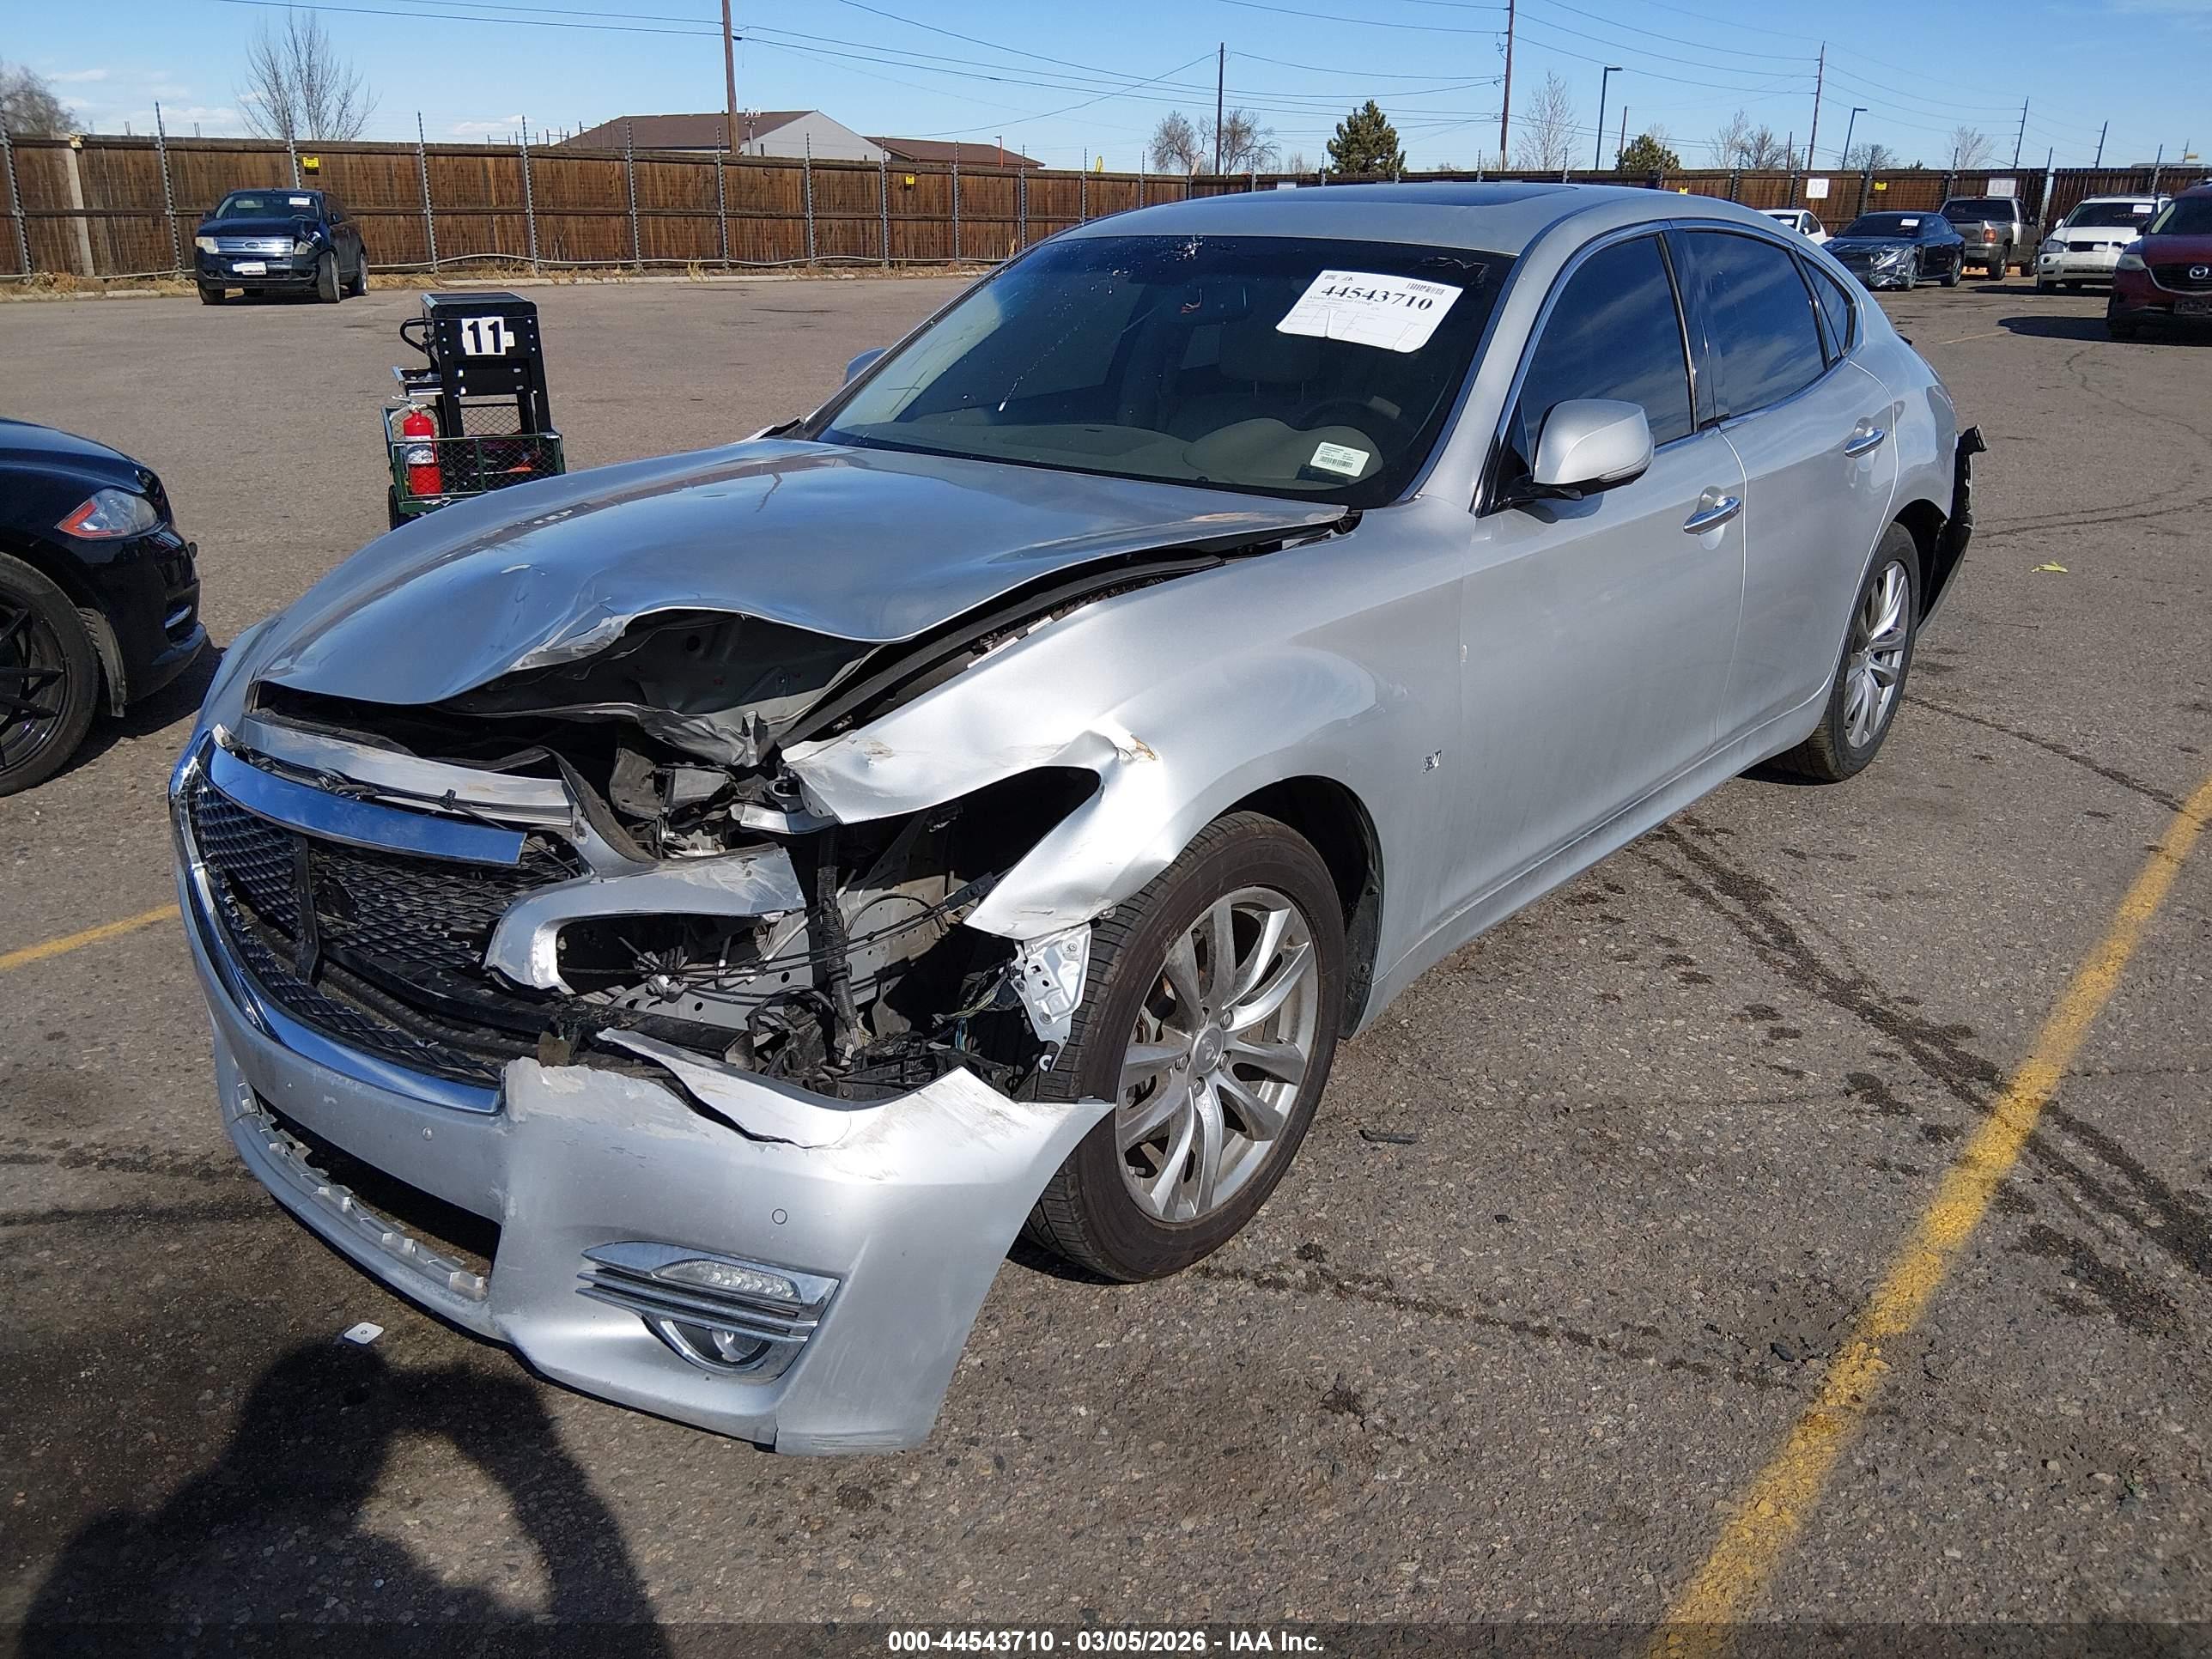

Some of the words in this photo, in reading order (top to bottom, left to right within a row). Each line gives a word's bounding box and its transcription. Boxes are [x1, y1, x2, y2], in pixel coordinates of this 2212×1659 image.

[1810, 180, 1826, 196] 02
[1321, 285, 1433, 310] 44543710
[467, 320, 502, 353] 11
